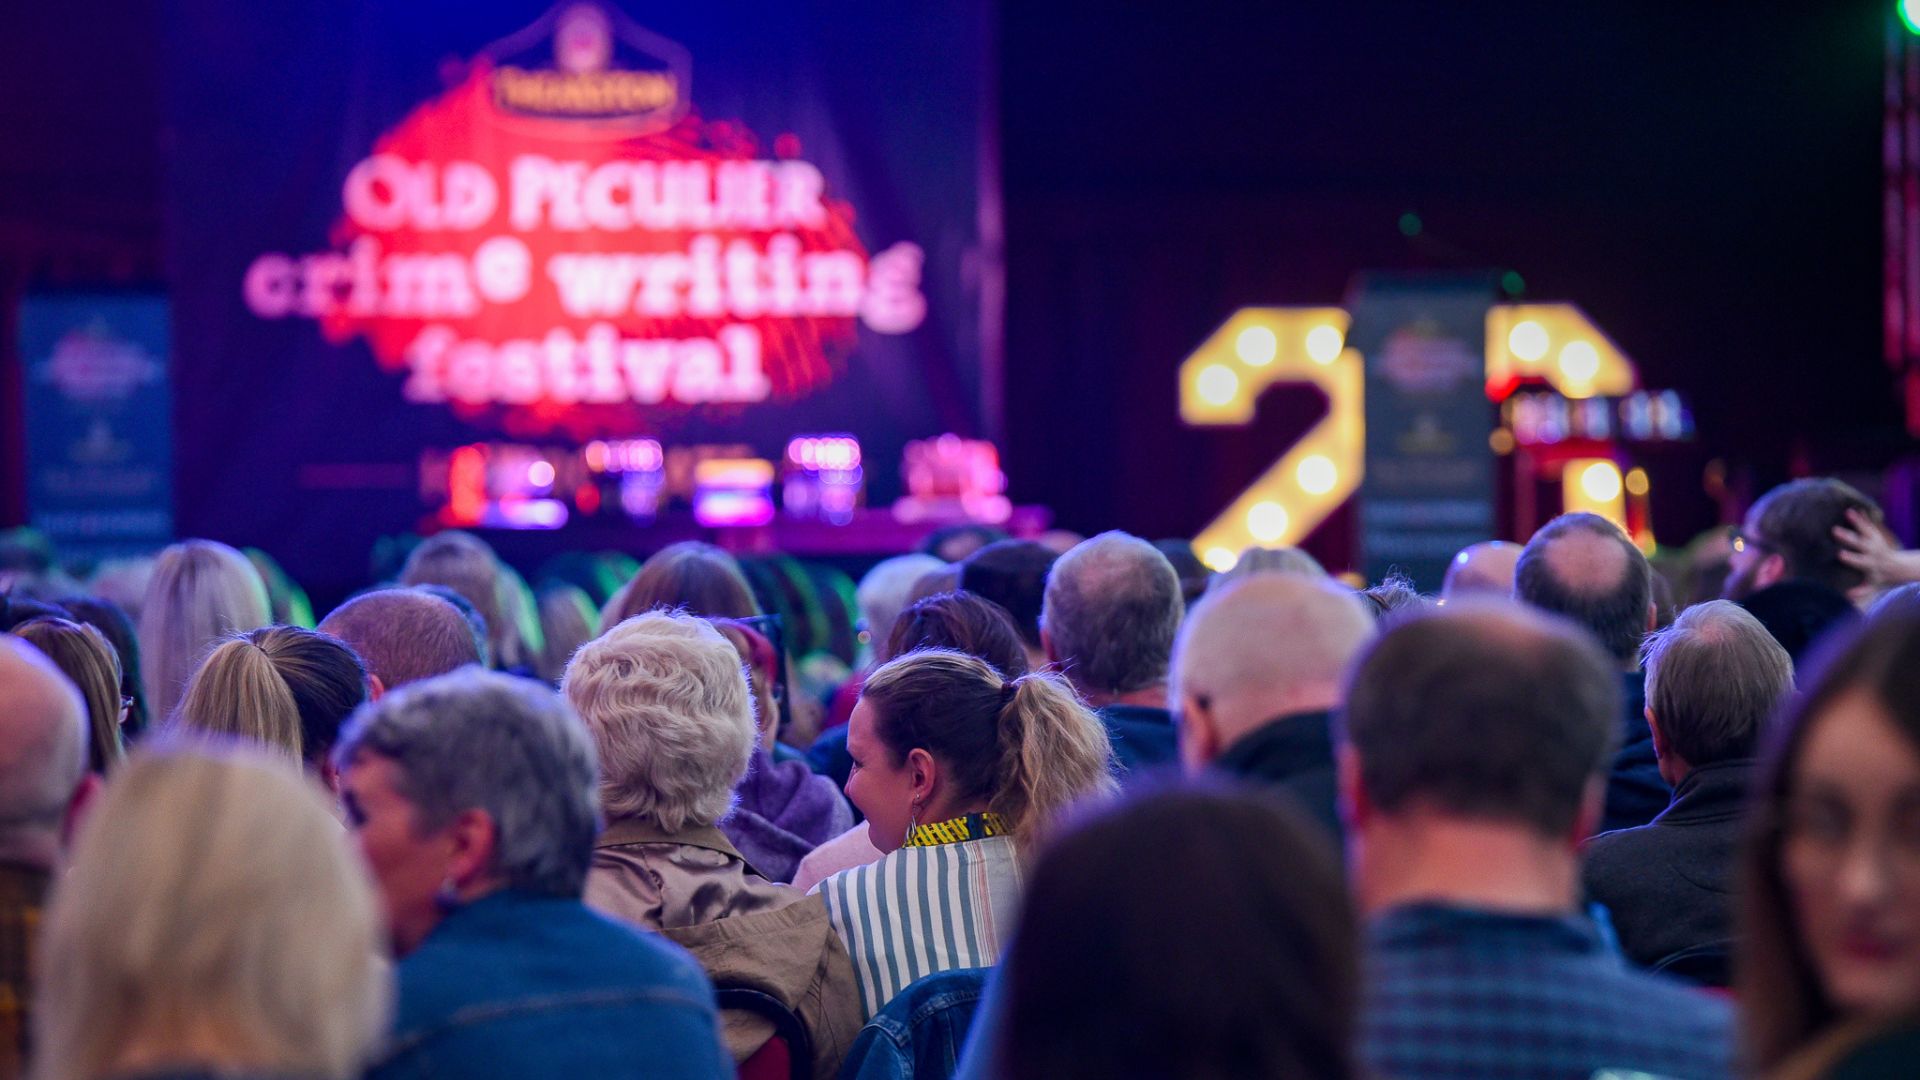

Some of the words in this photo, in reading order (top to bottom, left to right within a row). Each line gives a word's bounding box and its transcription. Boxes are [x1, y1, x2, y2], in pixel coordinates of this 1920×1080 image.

[343, 155, 498, 230] OLD
[509, 155, 827, 230] PECULIER
[244, 236, 533, 318] crime
[547, 235, 926, 334] writing
[404, 324, 770, 403] festival
